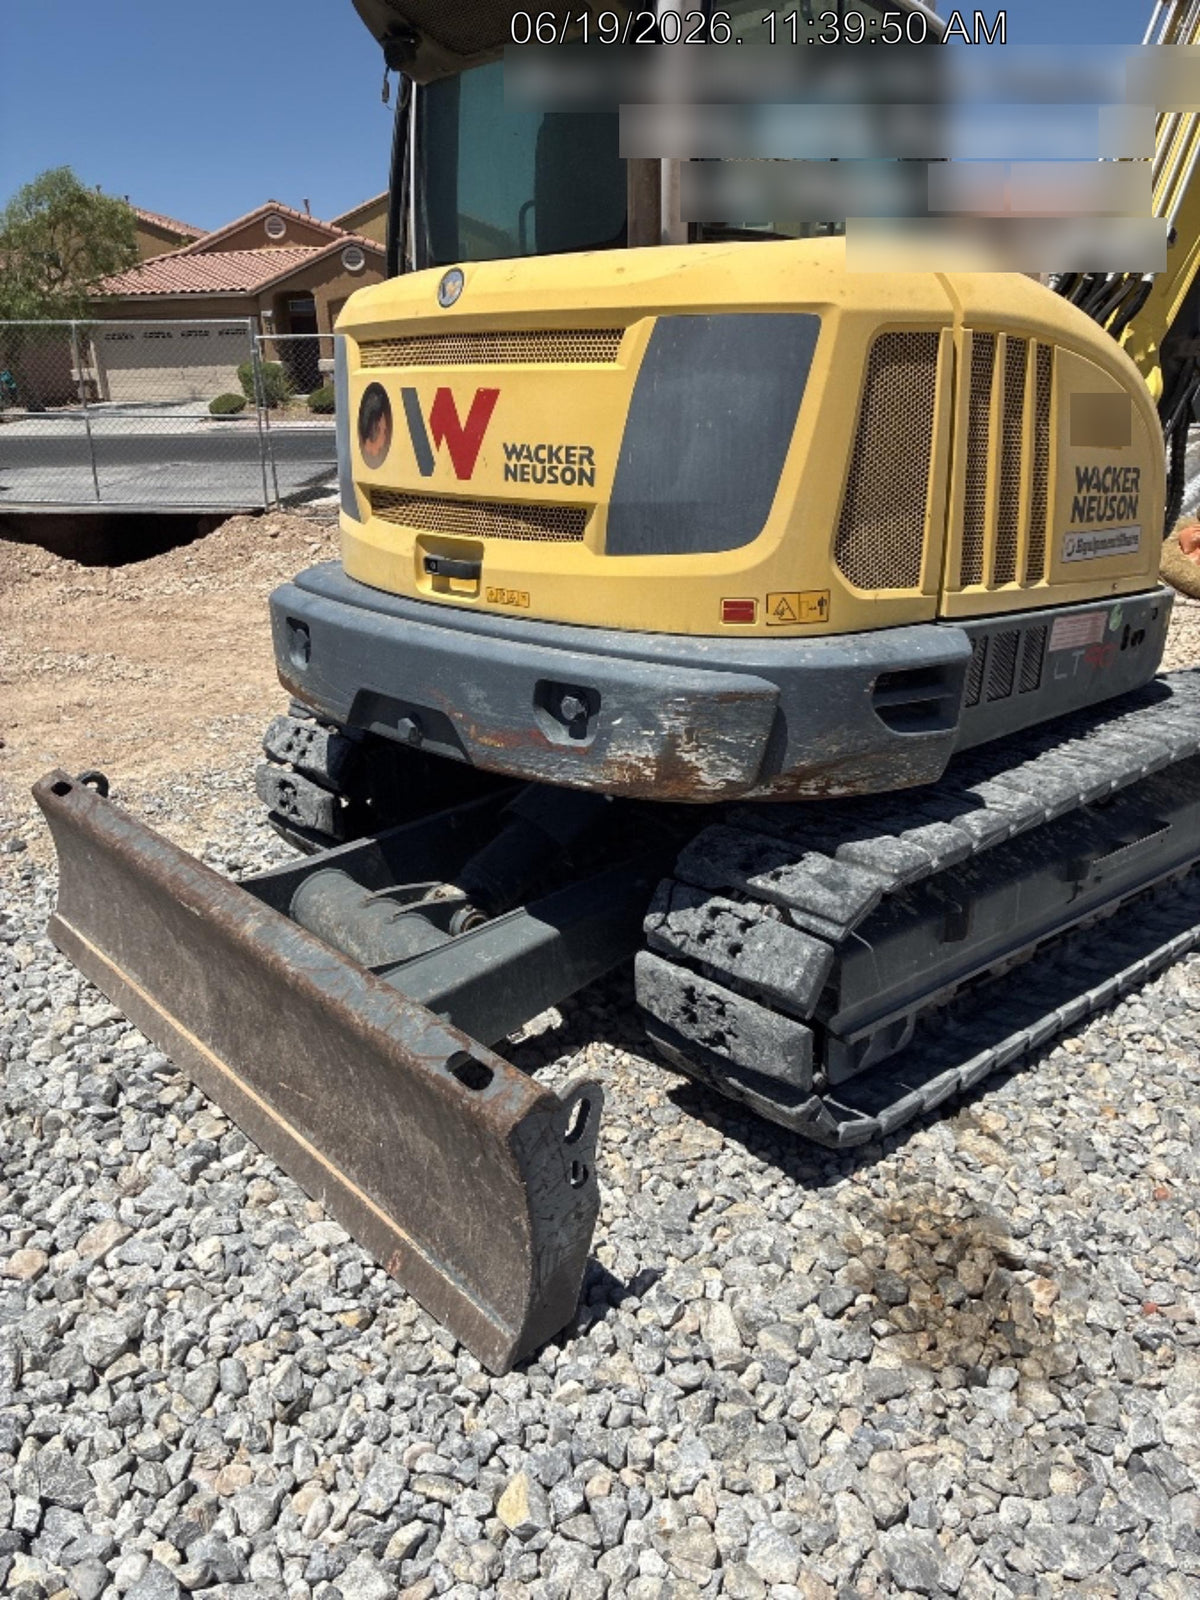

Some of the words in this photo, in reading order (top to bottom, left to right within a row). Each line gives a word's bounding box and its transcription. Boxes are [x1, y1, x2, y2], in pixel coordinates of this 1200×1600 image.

[502, 442, 596, 466] WACKER
[504, 463, 596, 487] NEUSON
[1075, 465, 1140, 494] WACKER
[1070, 495, 1139, 523] NEUSON
